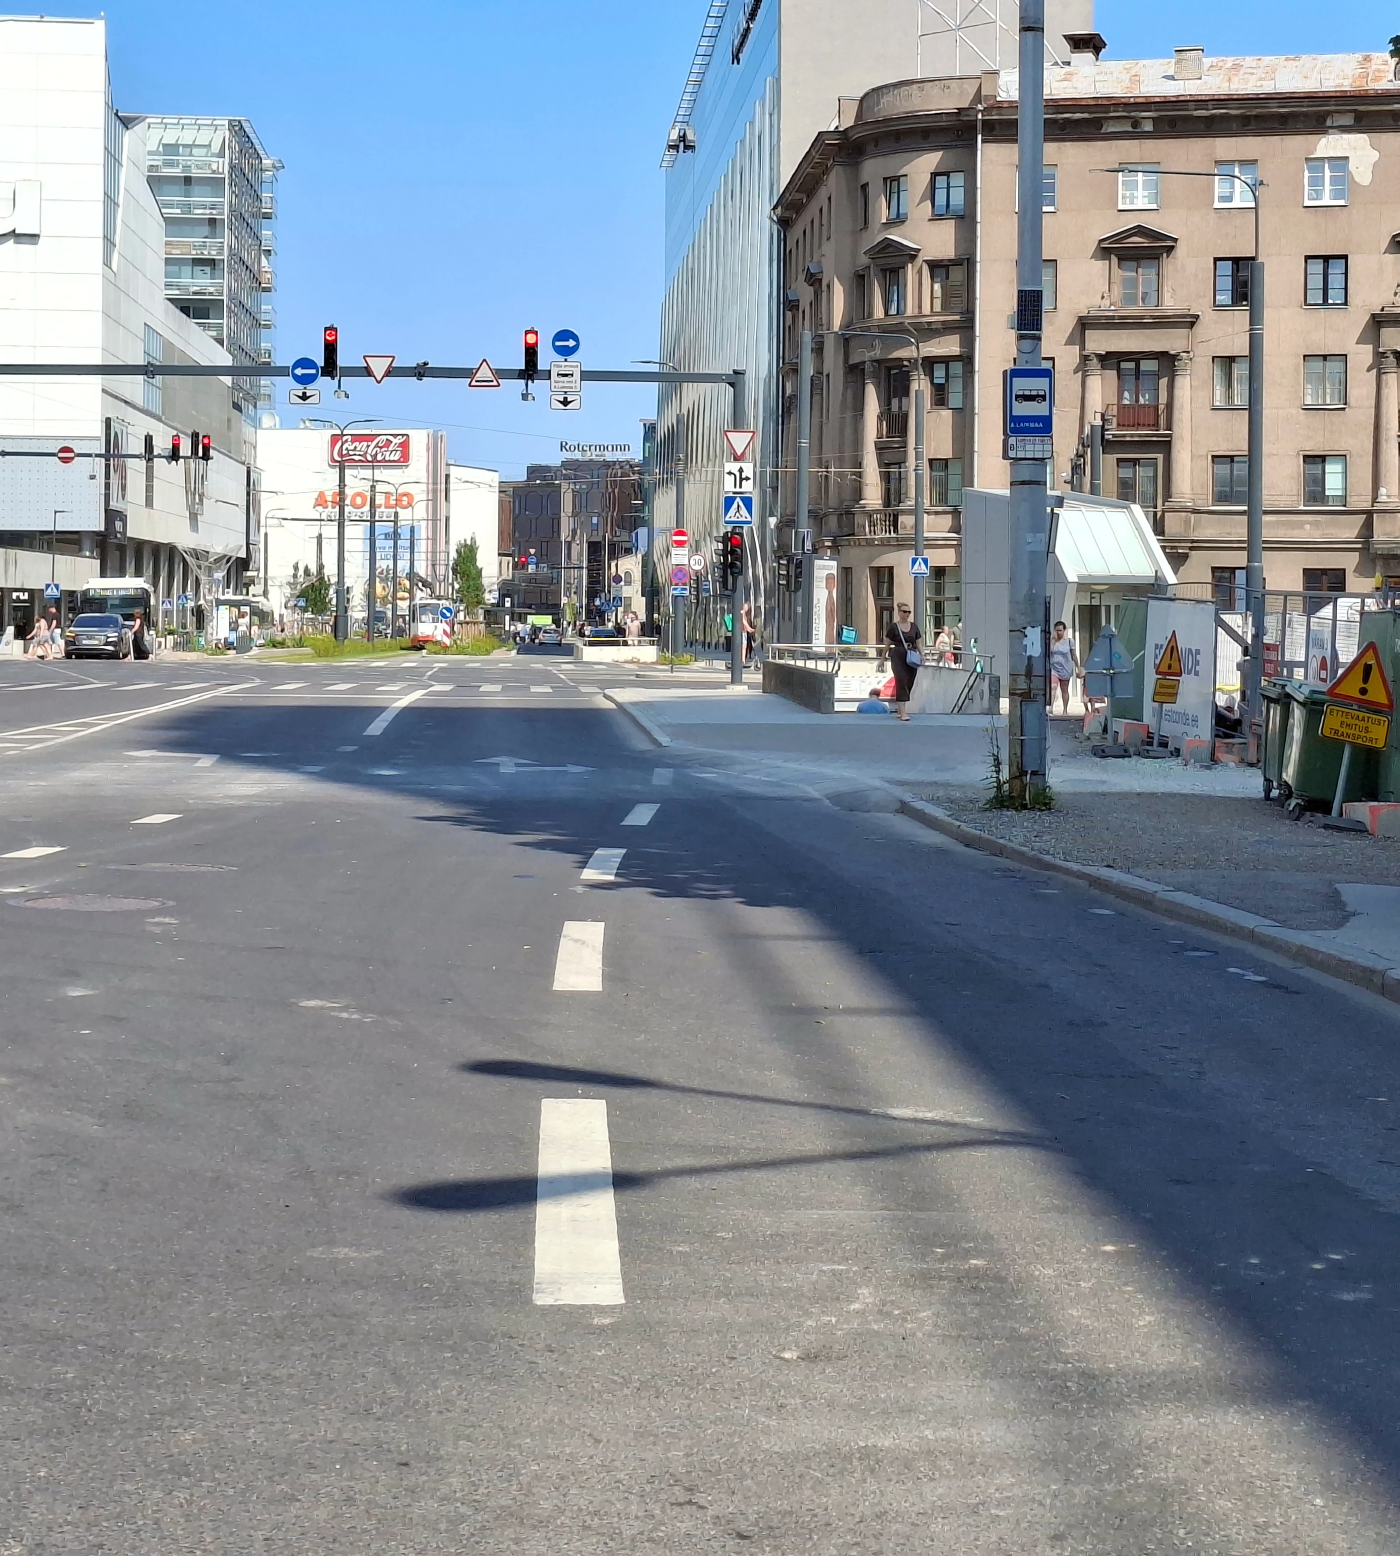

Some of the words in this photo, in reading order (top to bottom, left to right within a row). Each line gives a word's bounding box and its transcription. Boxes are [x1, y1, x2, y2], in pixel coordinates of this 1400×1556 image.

[560, 440, 631, 453] Rotermann
[1328, 708, 1387, 727] ETTEVAATUST
[1328, 727, 1380, 745] TRANSPORT
